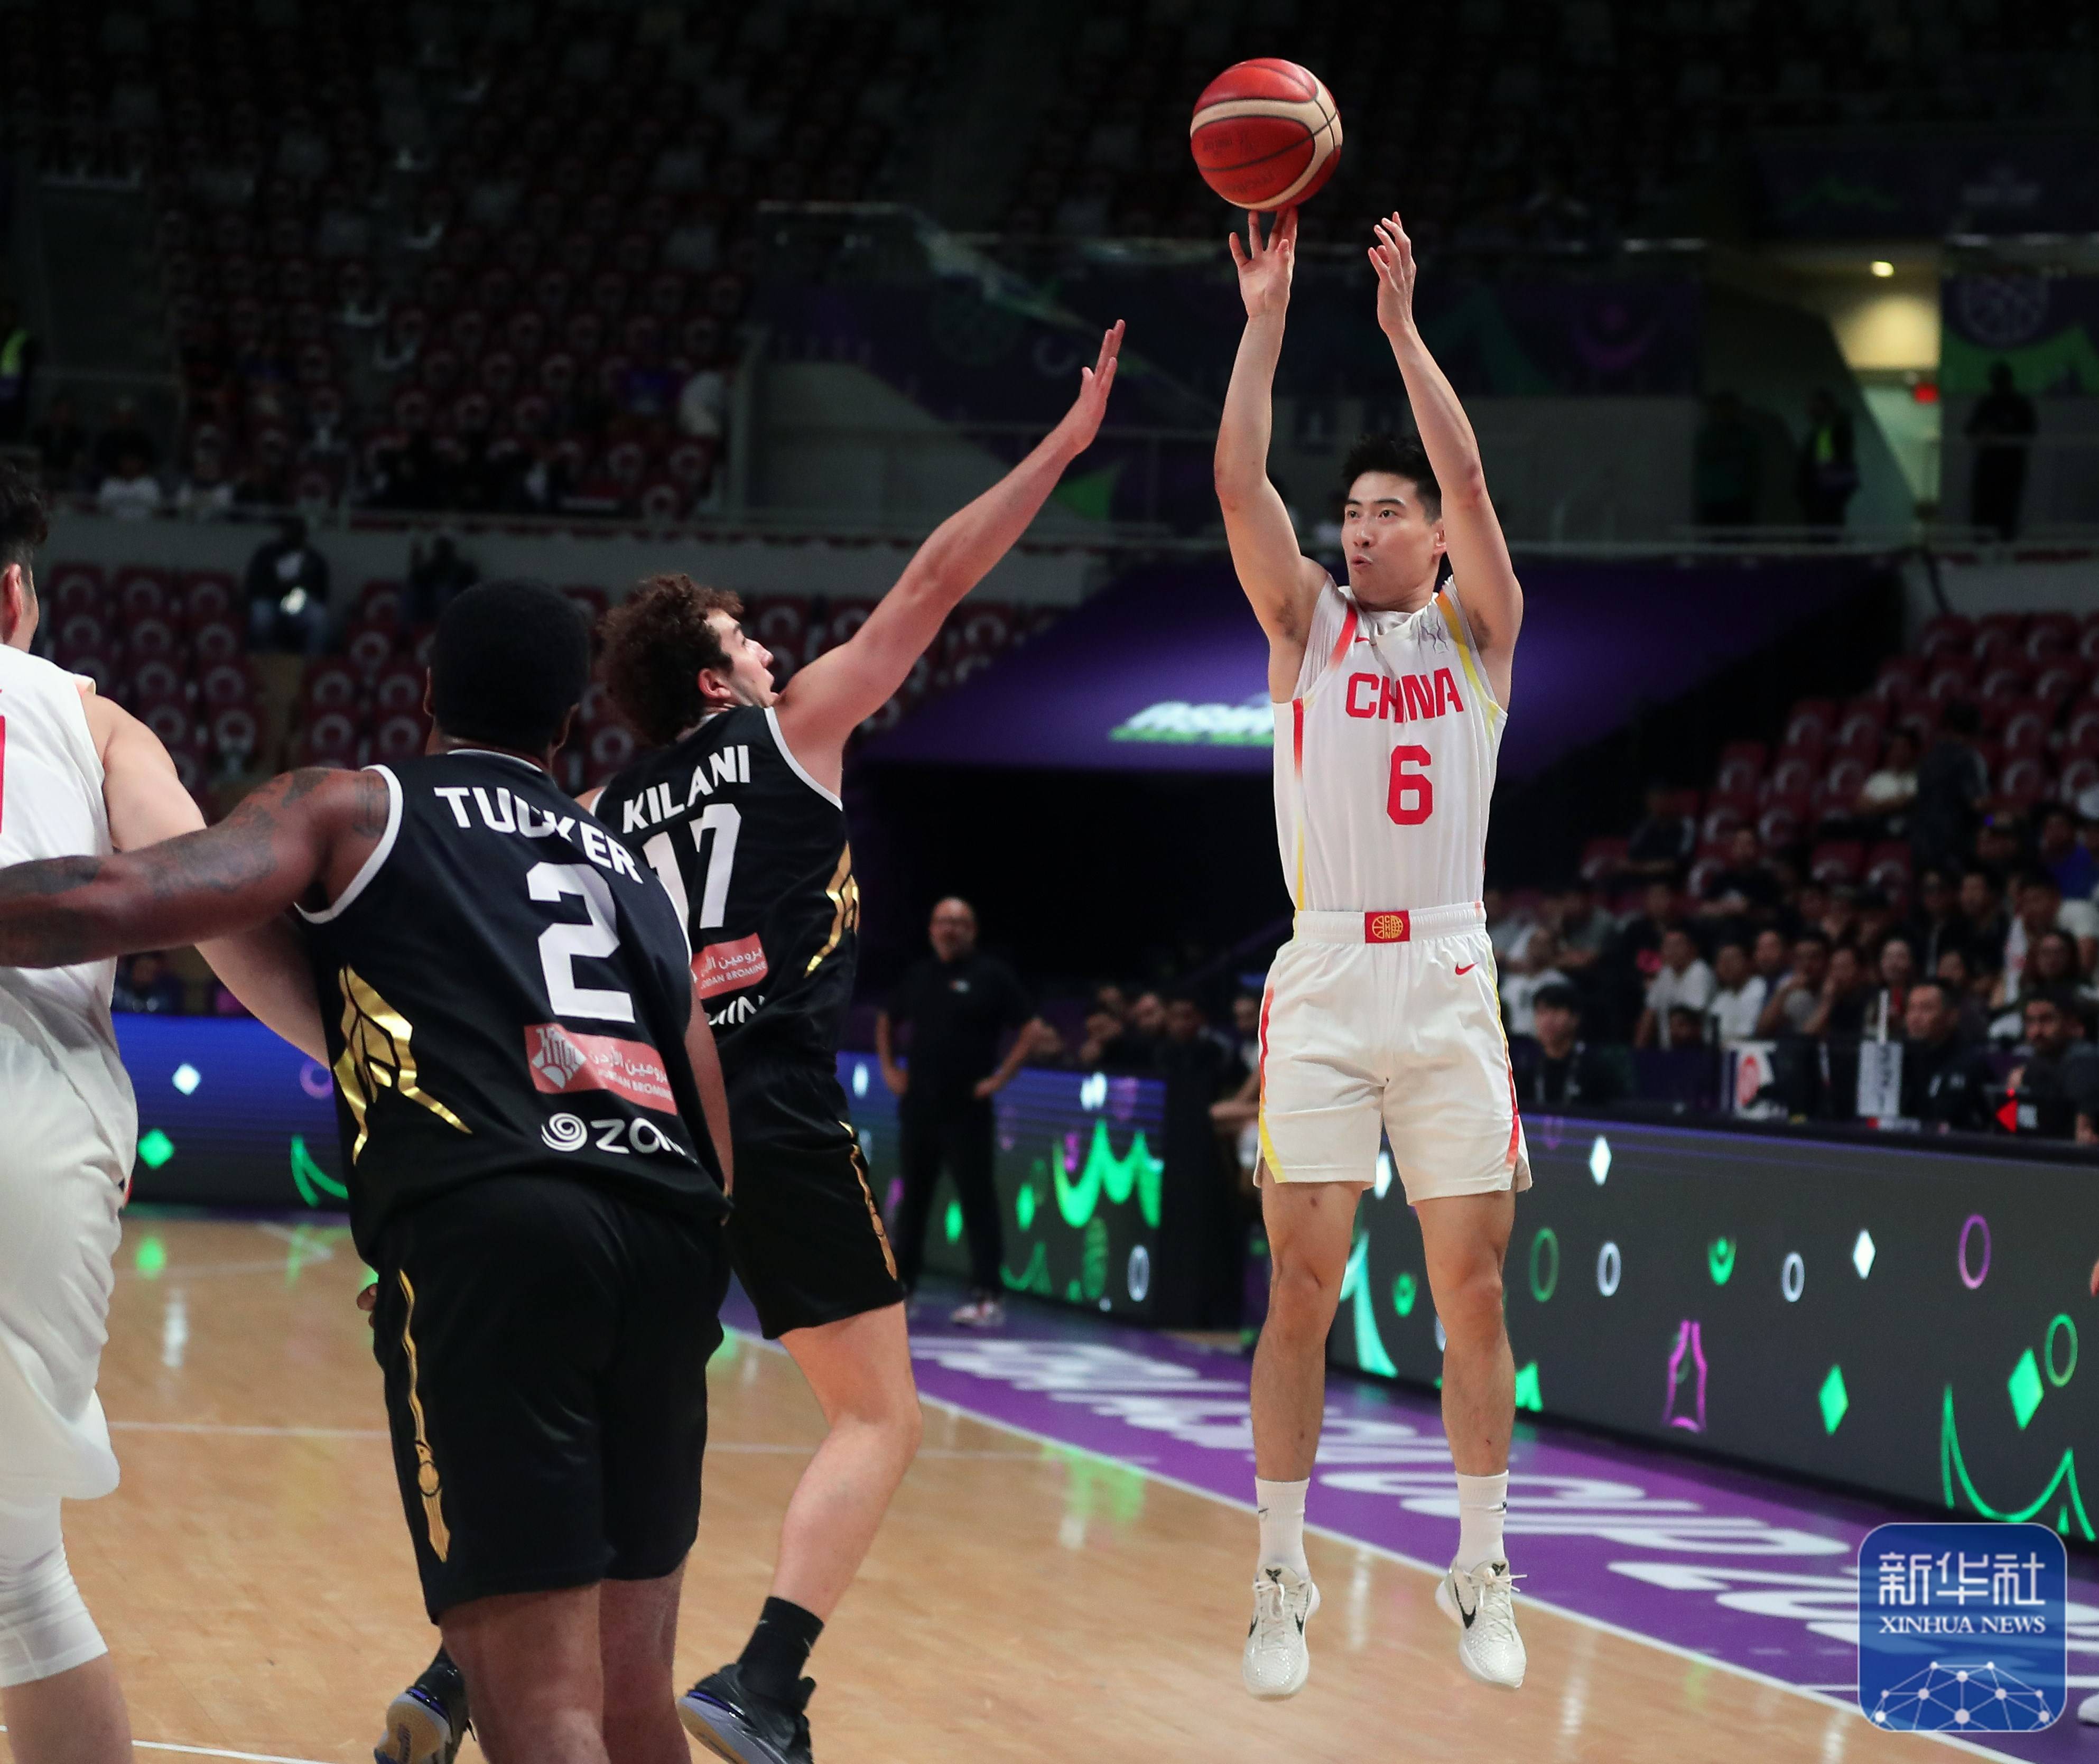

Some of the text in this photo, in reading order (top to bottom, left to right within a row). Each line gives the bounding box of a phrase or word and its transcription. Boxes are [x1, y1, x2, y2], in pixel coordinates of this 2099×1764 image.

[1345, 667, 1464, 723] CHNA
[623, 745, 751, 834] KILANI
[1387, 745, 1433, 825] 6
[642, 803, 741, 929] 17
[526, 861, 636, 1023] 2
